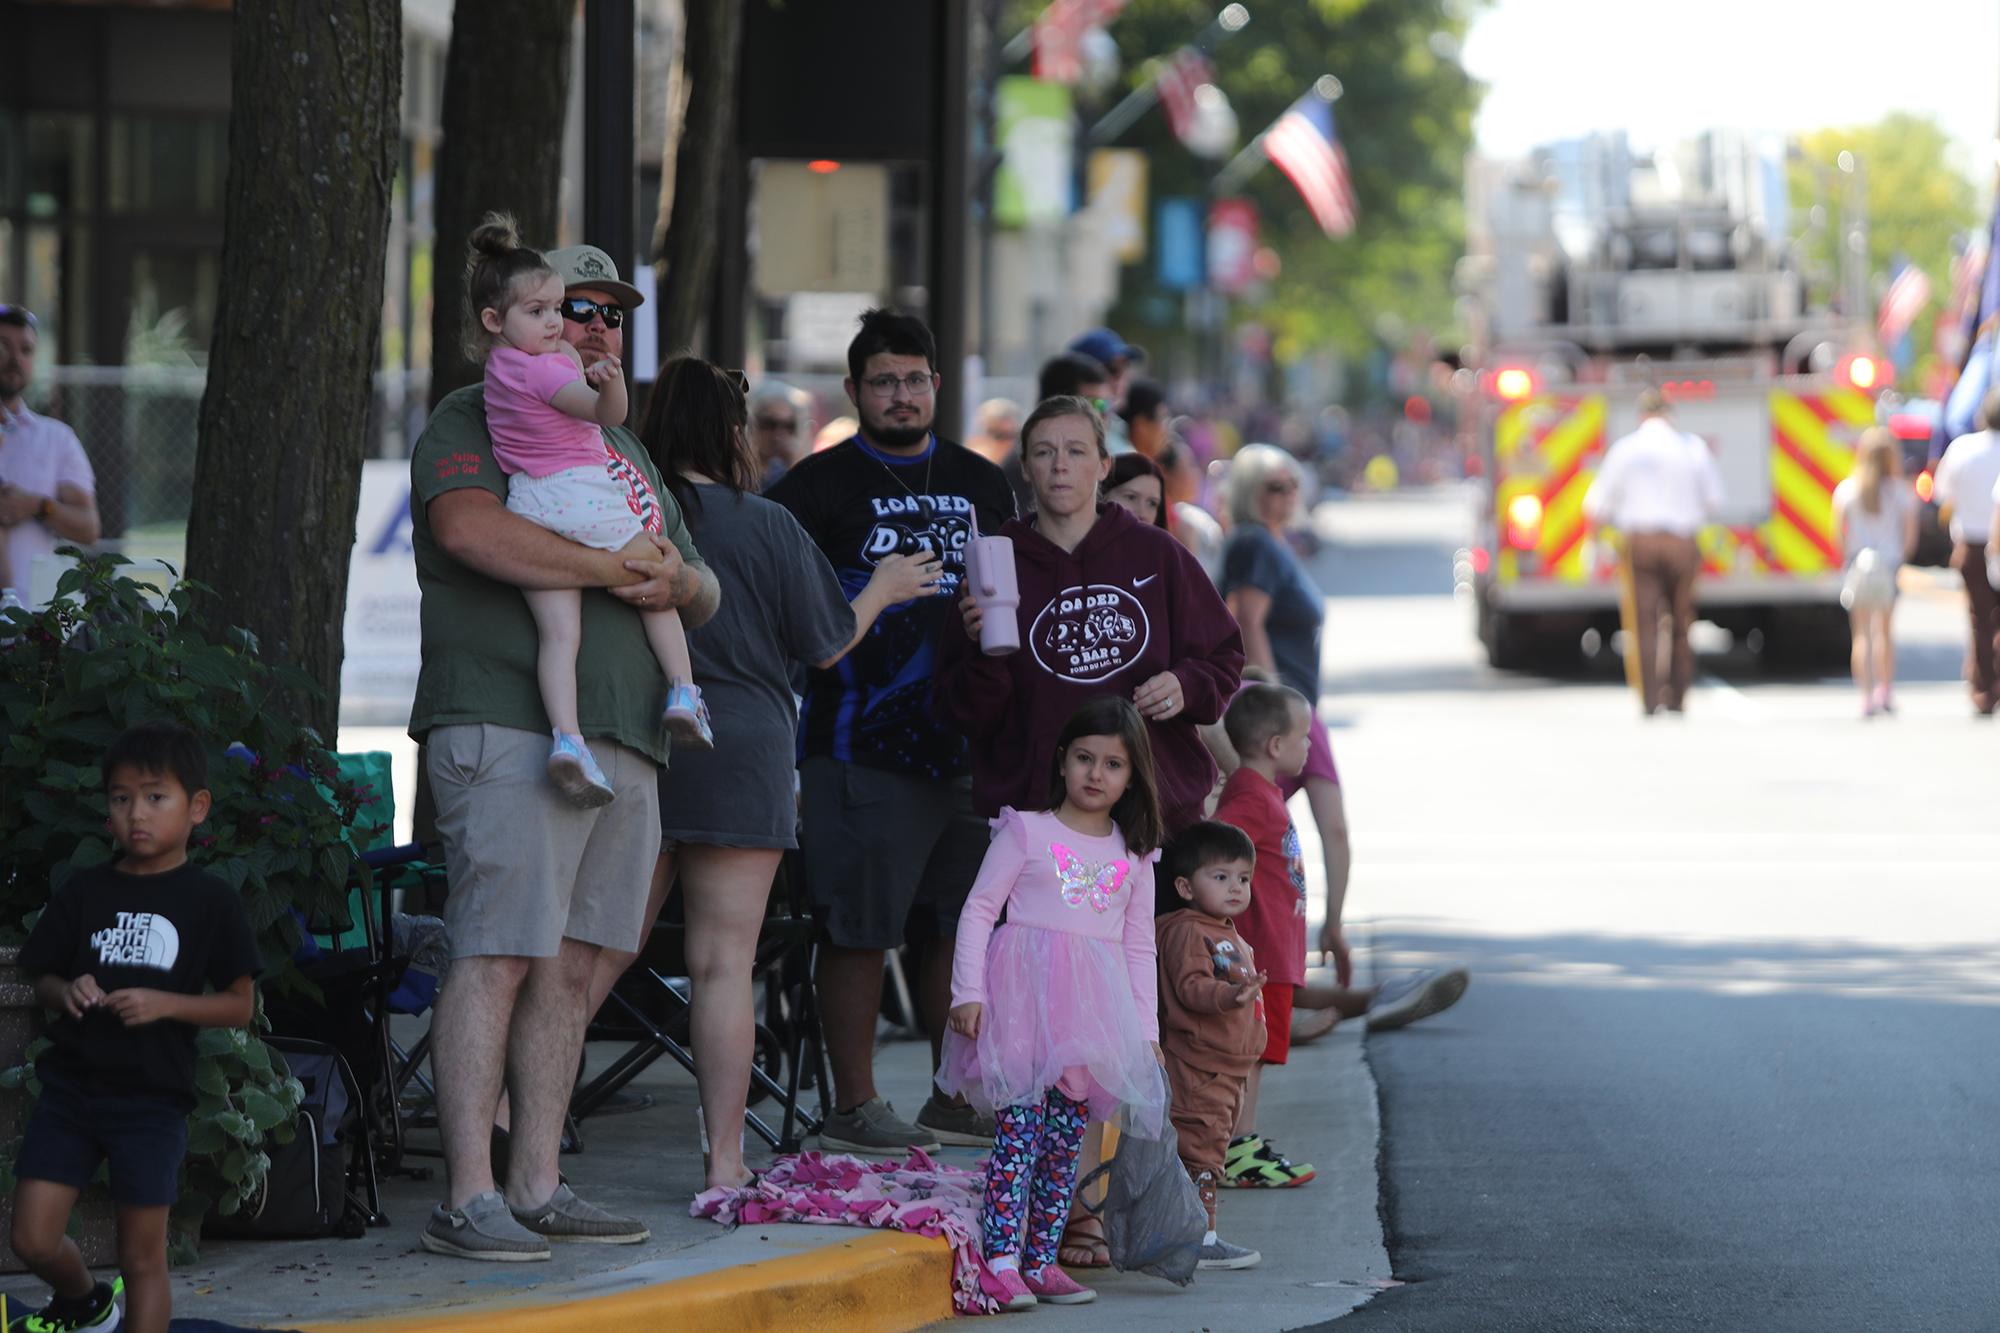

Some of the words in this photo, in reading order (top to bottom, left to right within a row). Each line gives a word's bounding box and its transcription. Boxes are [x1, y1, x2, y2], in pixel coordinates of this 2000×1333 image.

[871, 495, 971, 515] LOADED
[1082, 648, 1108, 662] BAR
[1070, 665, 1089, 674] FOND
[1090, 662, 1099, 670] DU
[116, 911, 151, 929] THE
[90, 927, 148, 949] NORTH
[100, 945, 145, 963] FACE
